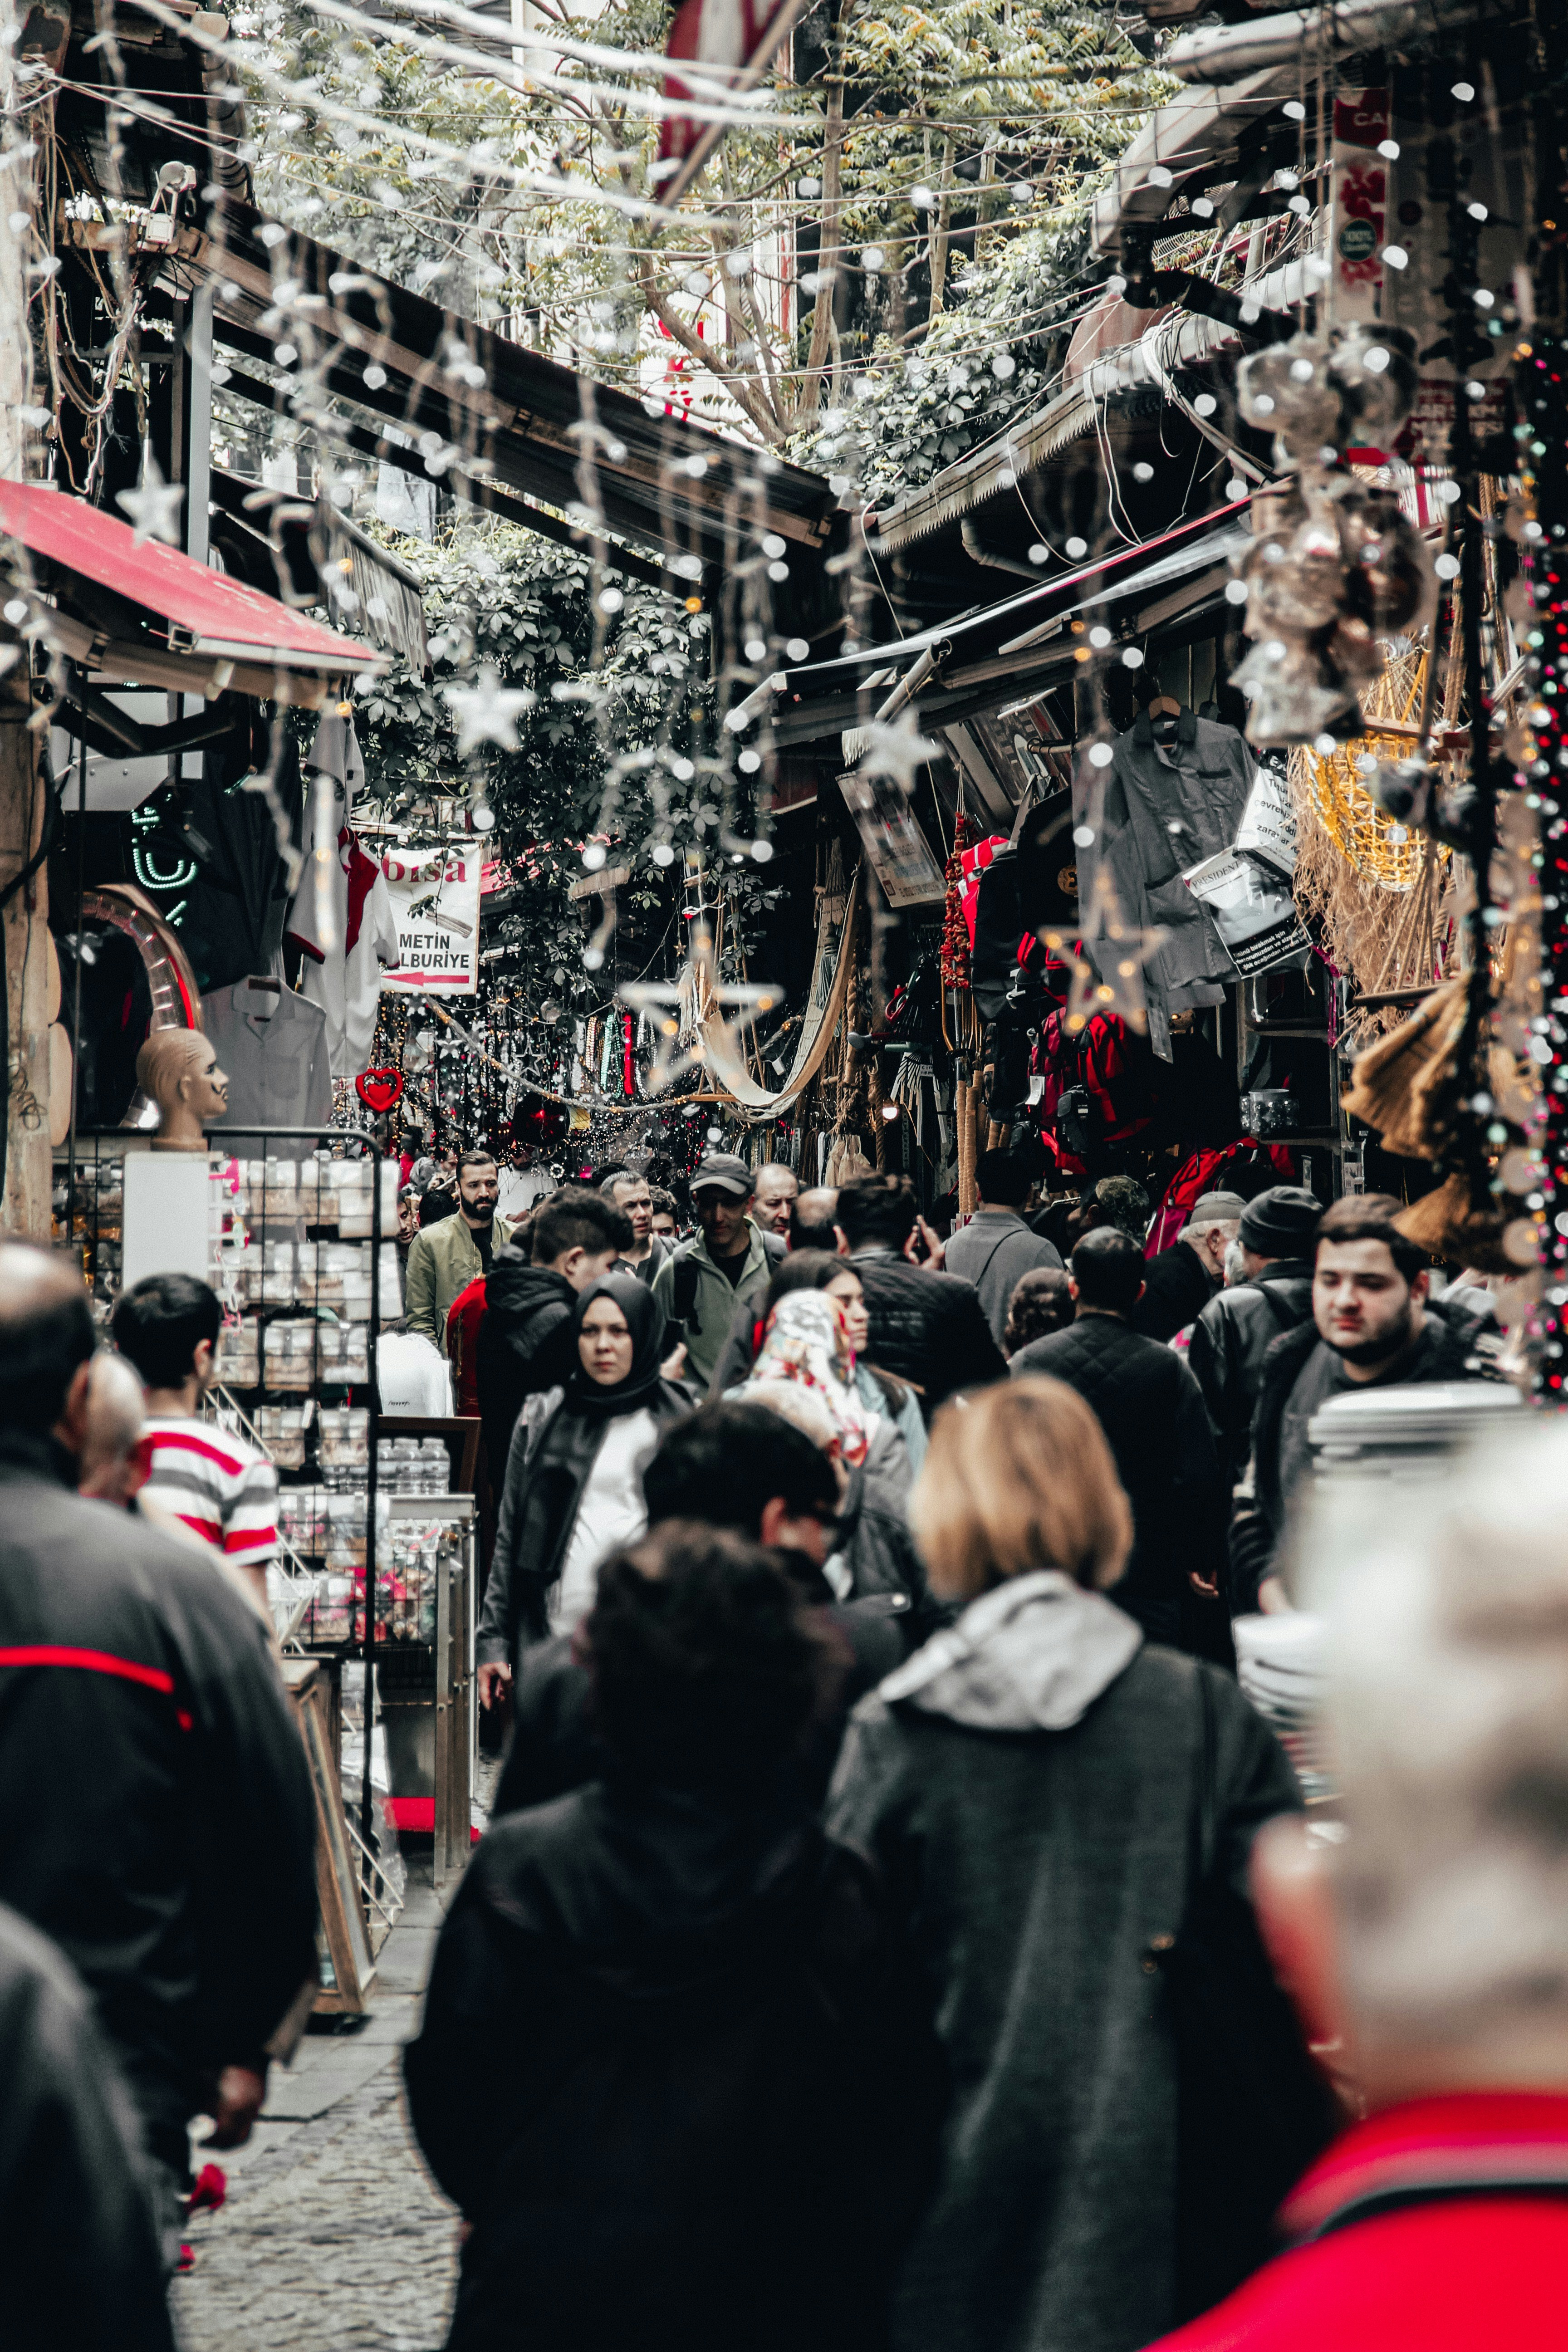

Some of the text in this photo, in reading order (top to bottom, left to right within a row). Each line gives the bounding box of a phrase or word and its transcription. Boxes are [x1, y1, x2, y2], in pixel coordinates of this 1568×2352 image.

[1191, 861, 1240, 889] PRESIDENT
[399, 931, 450, 949] METİN
[401, 951, 470, 968] LBURİYE
